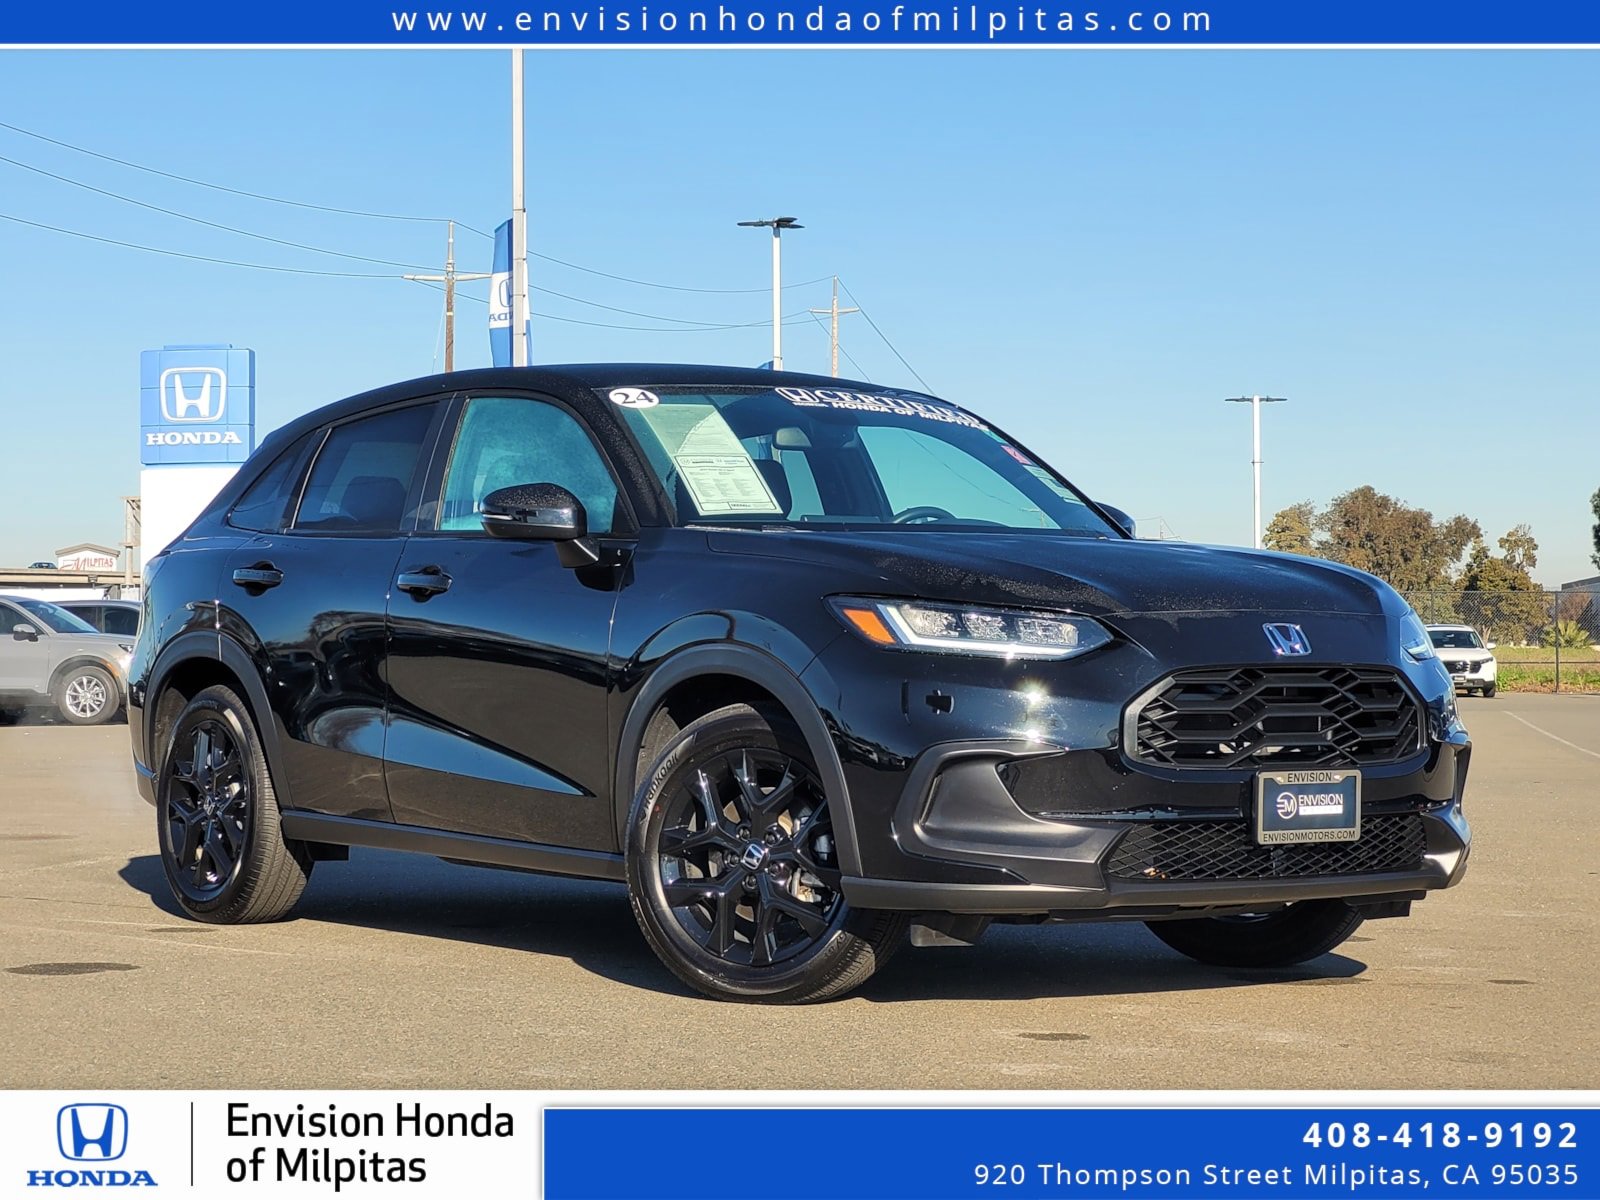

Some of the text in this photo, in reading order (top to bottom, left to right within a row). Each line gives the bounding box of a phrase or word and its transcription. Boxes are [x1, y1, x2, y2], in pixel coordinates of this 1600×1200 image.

[613, 391, 654, 404] 24
[832, 402, 892, 413] HONDA
[894, 407, 915, 416] OF
[146, 431, 243, 446] HONDA
[1287, 772, 1332, 784] ENVISION
[1298, 793, 1343, 806] ENVISION
[1263, 830, 1356, 843] ENVISIONMOTORS.COM
